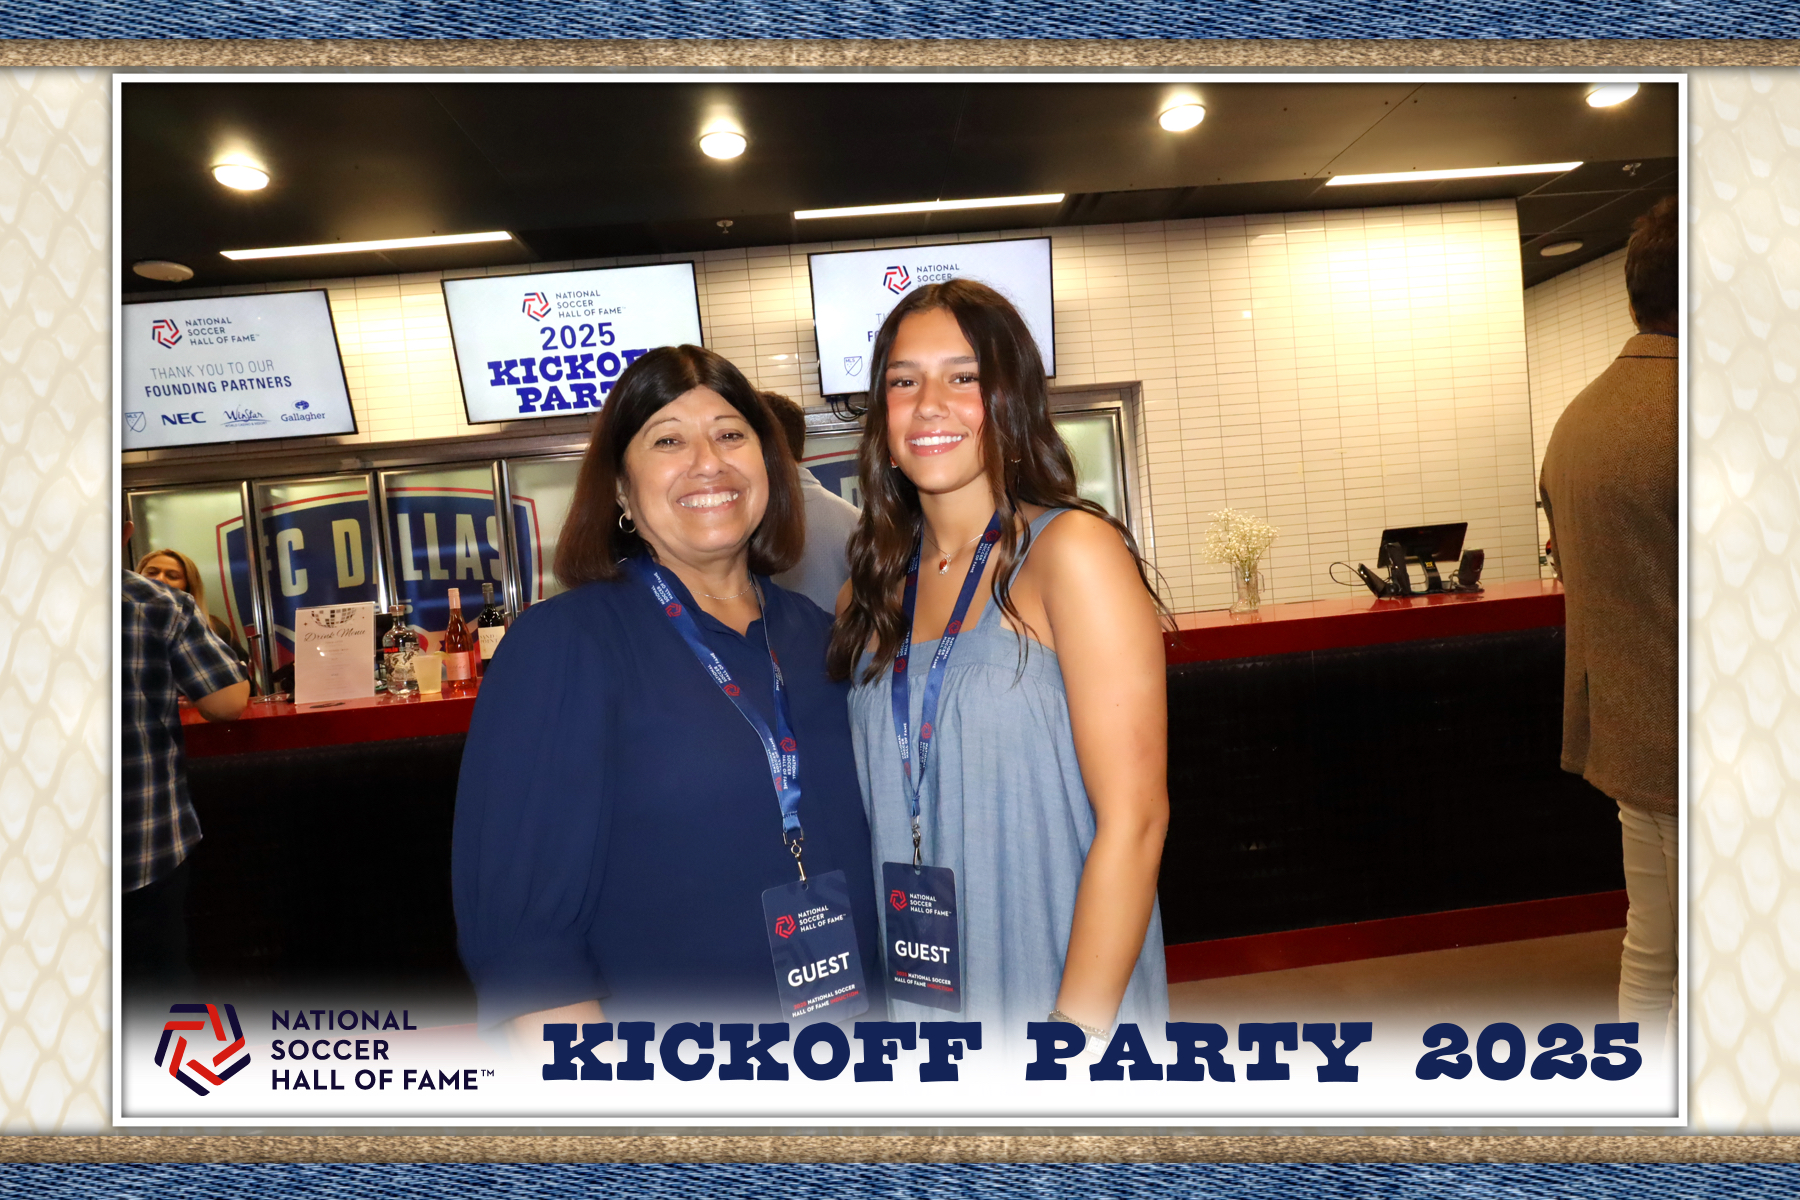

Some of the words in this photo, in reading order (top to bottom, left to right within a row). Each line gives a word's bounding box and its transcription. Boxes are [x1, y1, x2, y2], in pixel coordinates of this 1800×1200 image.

[916, 264, 960, 273] NATIONAL
[917, 274, 952, 282] SOCCER
[556, 290, 600, 300] NATIONAL
[557, 300, 594, 309] SOCCER
[558, 310, 582, 318] HALL
[185, 317, 232, 327] NATIONAL
[188, 326, 226, 336] SOCCER
[540, 322, 616, 350] 2025
[190, 338, 214, 346] HALL
[150, 365, 195, 380] THANK
[197, 364, 224, 377] YOU
[227, 362, 244, 374] TO
[248, 360, 275, 374] OUR
[144, 381, 217, 398] FOUNDING
[220, 375, 292, 392] PARTNERS
[161, 411, 206, 426] NEC
[223, 404, 264, 422] WinStar
[280, 412, 326, 422] Gallagher
[304, 632, 335, 642] Drink
[336, 628, 366, 638] Menu
[910, 893, 937, 902] NATIONAL
[910, 900, 932, 908] SOCCER
[798, 904, 829, 918] NATIONAL
[799, 912, 825, 926] SOCCER
[800, 923, 816, 932] HALL
[894, 940, 950, 964] GUEST
[788, 952, 850, 987] GUEST
[908, 972, 932, 982] NATIONAL
[932, 977, 952, 986] SOCCER
[926, 983, 954, 992] INDUCTION
[807, 992, 834, 1005] NATIONAL
[834, 984, 856, 996] SOCCER
[792, 1008, 807, 1018] HALL
[815, 1000, 830, 1010] FAME
[830, 990, 860, 1004] INDUCTION
